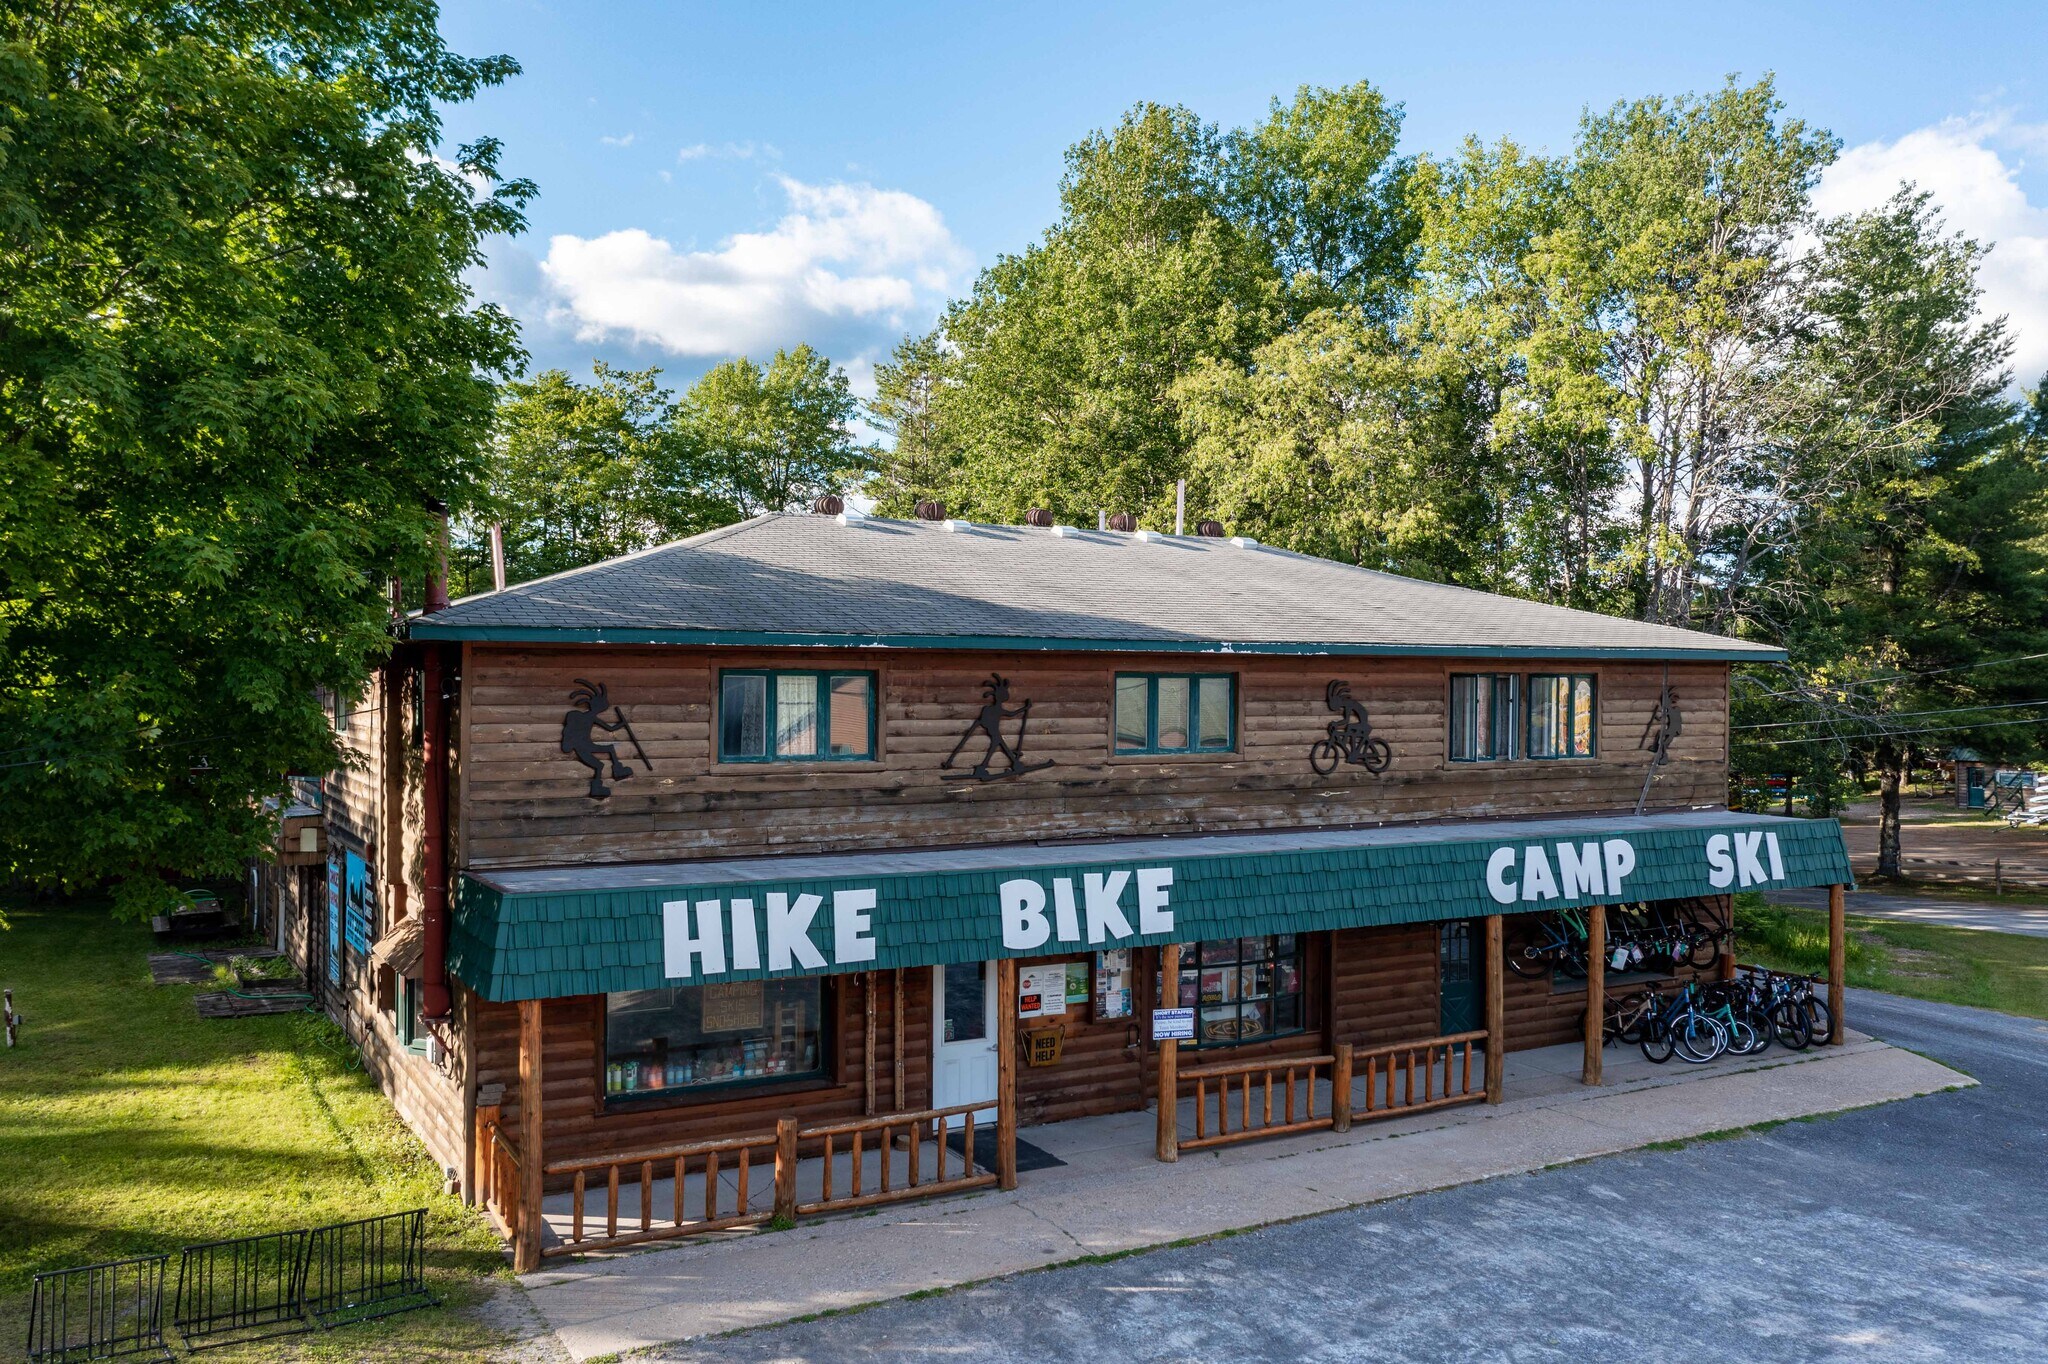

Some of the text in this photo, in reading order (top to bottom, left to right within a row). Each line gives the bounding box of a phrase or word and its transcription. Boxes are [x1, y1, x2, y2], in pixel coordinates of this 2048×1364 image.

[663, 831, 1785, 978] HIKE BIKE CAMP SKI
[709, 983, 759, 999] CAMPING
[720, 999, 746, 1013] SKIS
[1021, 1002, 1041, 1010] WANTED
[1209, 1021, 1259, 1035] KEEN
[1036, 1037, 1056, 1050] NEED
[1036, 1049, 1055, 1062] HELP
